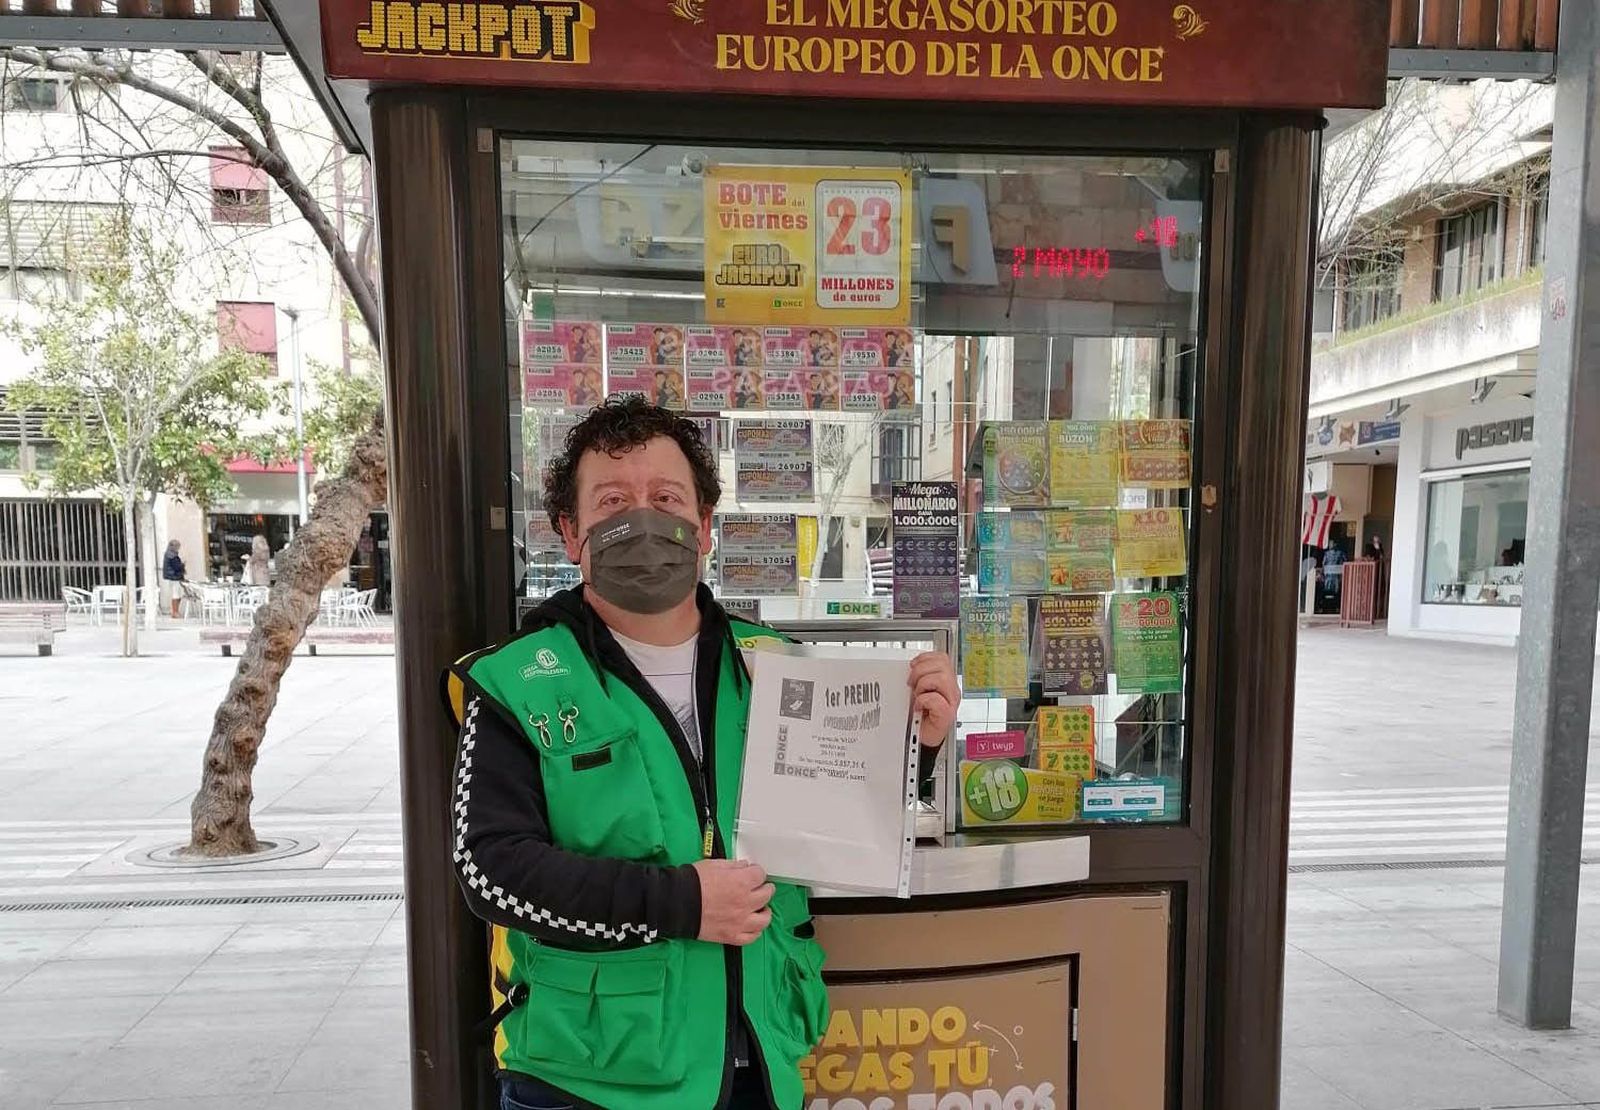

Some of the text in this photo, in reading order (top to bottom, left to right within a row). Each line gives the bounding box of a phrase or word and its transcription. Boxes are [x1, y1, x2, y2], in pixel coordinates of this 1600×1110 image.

[357, 1, 577, 58] JACKPOT
[766, 0, 1118, 37] EL MEGASORTEO
[716, 33, 1164, 82] EUROPEO DE LA ONCE
[719, 183, 787, 206] BOTE
[719, 209, 808, 230] viernes
[826, 196, 892, 256] 23
[733, 243, 782, 266] EURO
[1033, 245, 1111, 281] MAYO
[716, 264, 801, 287] JACKPOT
[821, 277, 895, 291] MILLONES
[833, 293, 882, 303] de euros
[777, 420, 804, 429] 26907
[778, 462, 806, 470] 26907
[910, 482, 941, 498] Mega
[893, 496, 958, 511] MILLONARIO
[893, 515, 958, 526] 1.000.000€
[842, 604, 879, 614] ONCE
[825, 687, 841, 707] 1er
[844, 681, 881, 705] PREMIO
[776, 726, 789, 761] ONCE
[786, 765, 817, 778] ONCE
[968, 765, 1021, 813] +18
[821, 1006, 967, 1049] ANDO
